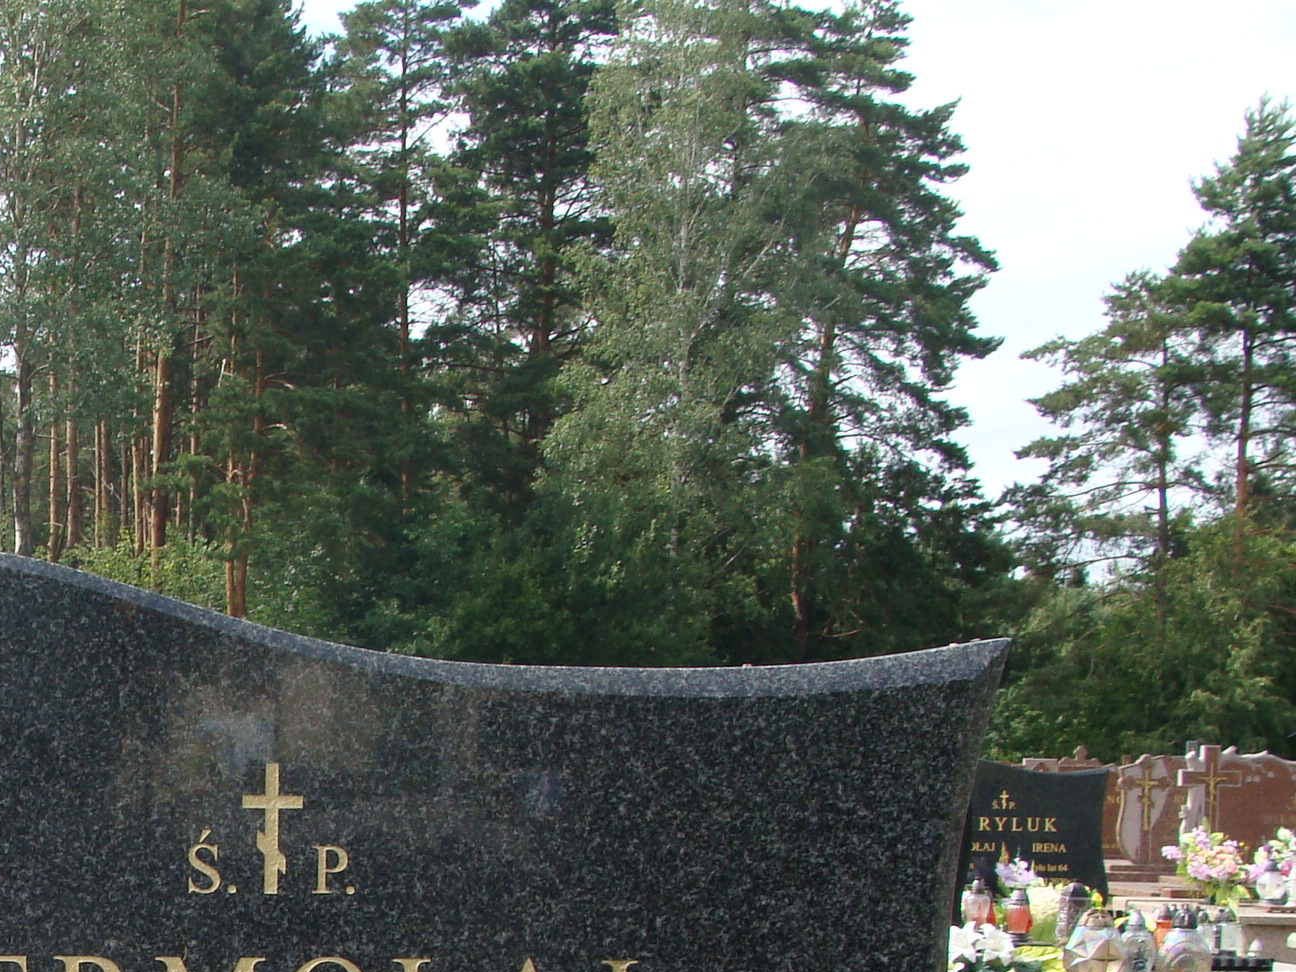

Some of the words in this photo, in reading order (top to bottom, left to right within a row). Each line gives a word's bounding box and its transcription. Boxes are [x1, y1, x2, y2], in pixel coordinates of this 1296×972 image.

[978, 817, 1057, 832] RYLUK
[1031, 842, 1067, 853] IRENA
[186, 829, 238, 895] Ś.
[311, 844, 357, 896] P.
